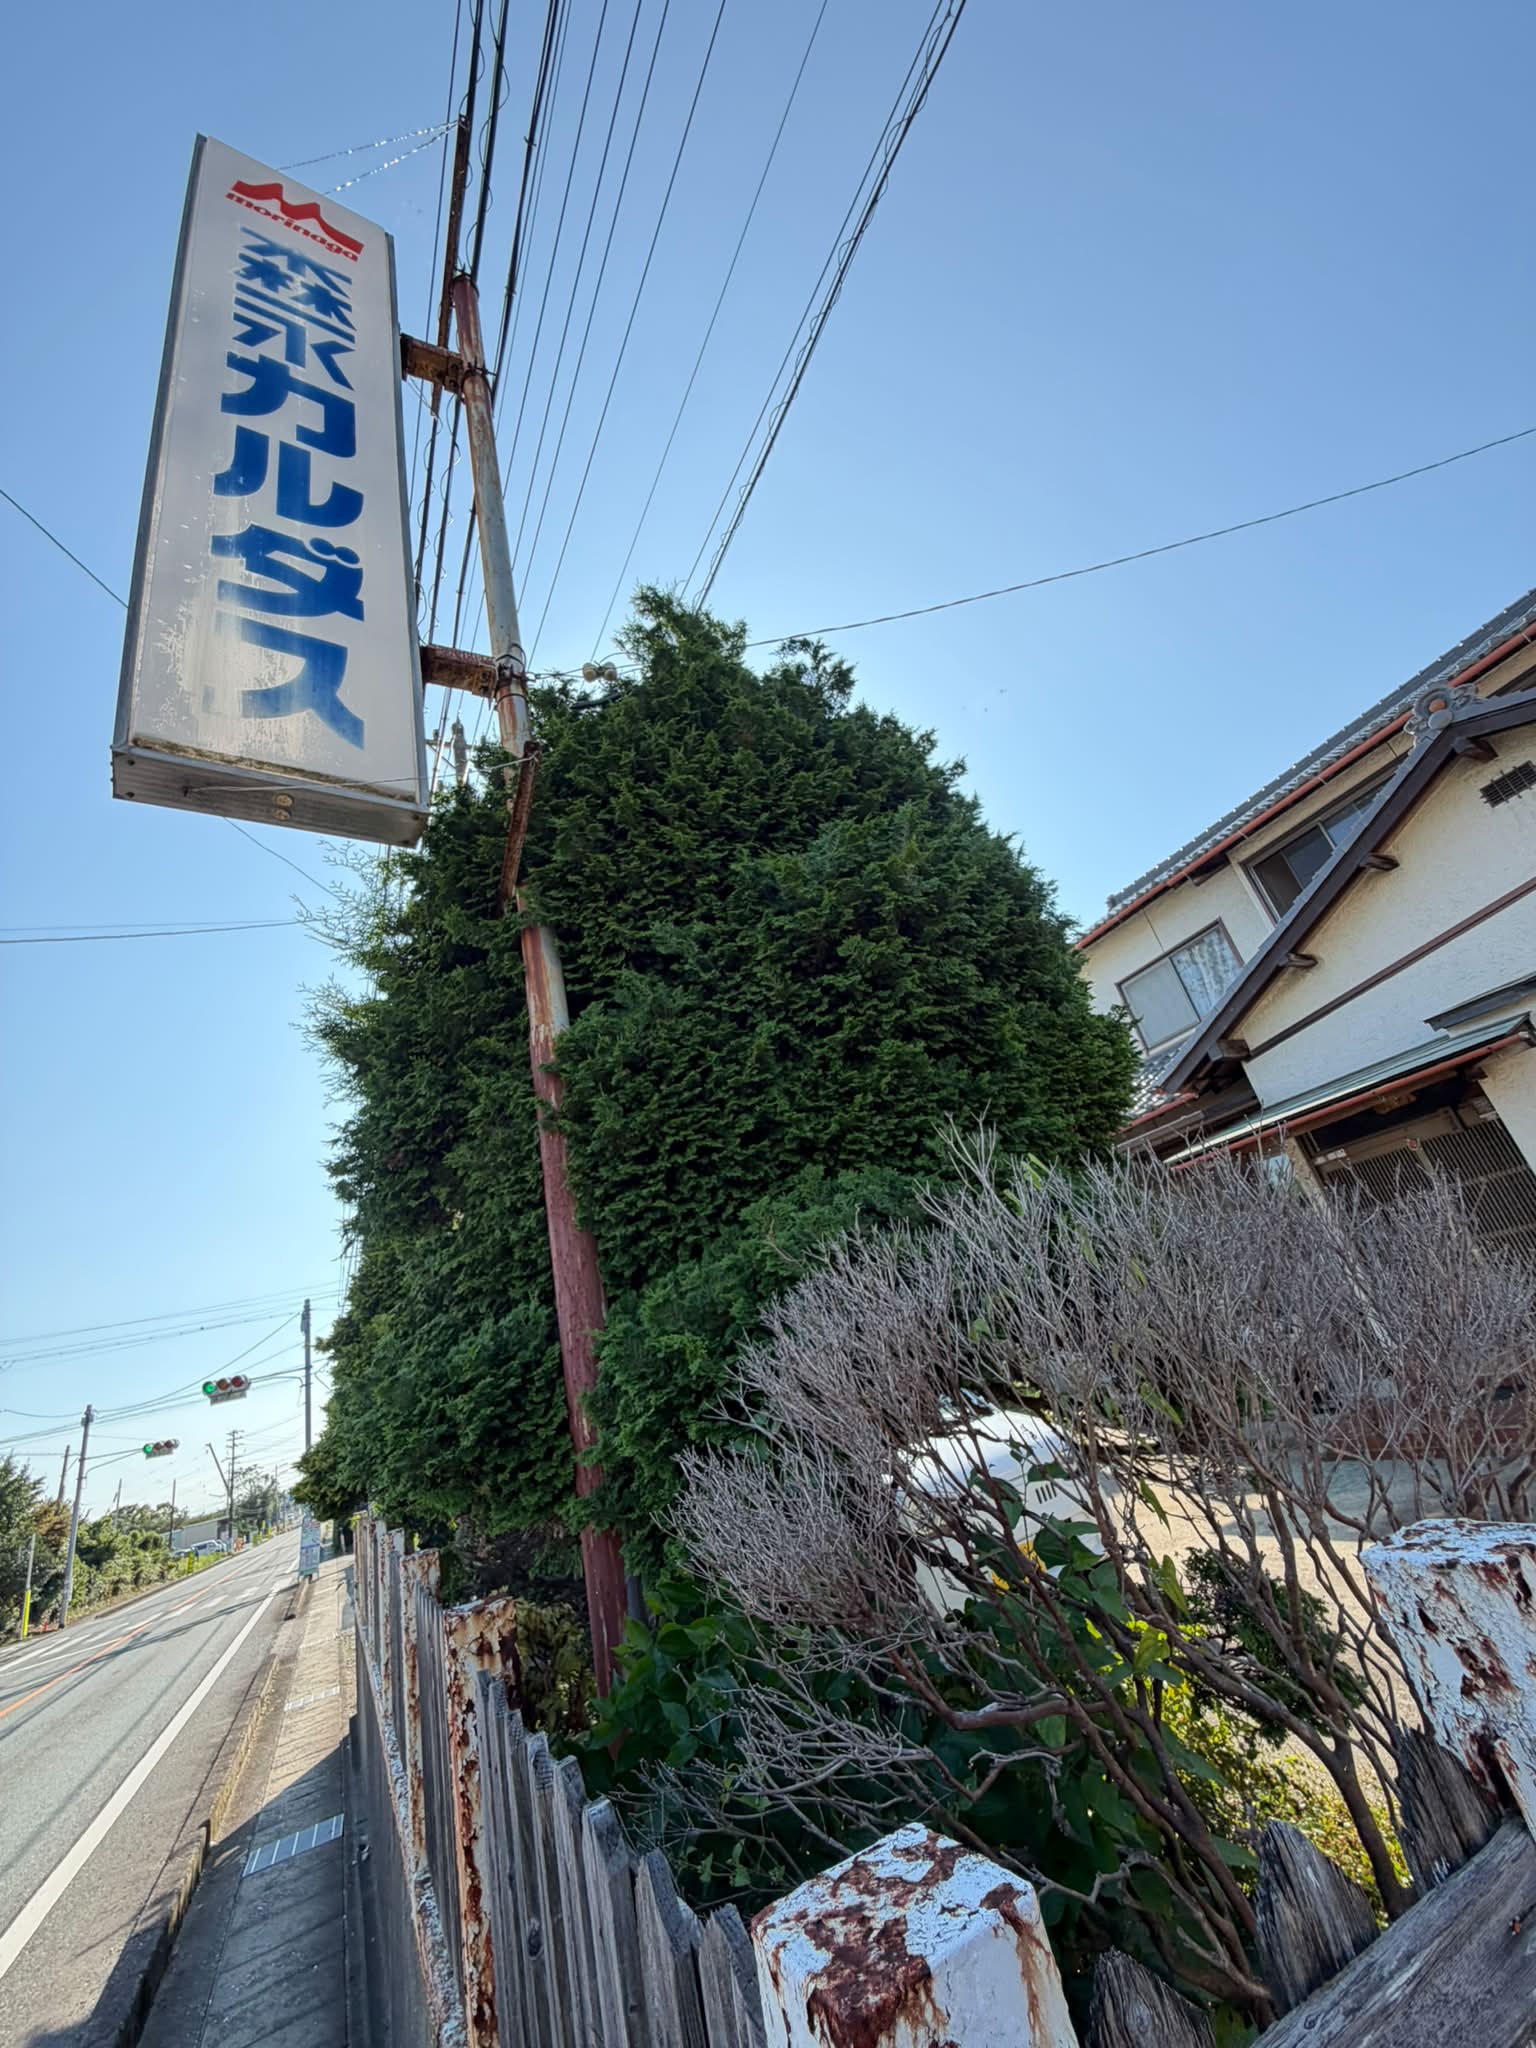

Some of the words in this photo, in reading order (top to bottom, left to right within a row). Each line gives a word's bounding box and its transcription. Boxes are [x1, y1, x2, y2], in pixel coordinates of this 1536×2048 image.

[225, 192, 359, 262] morinaga
[206, 226, 365, 750] 森永カルダス
